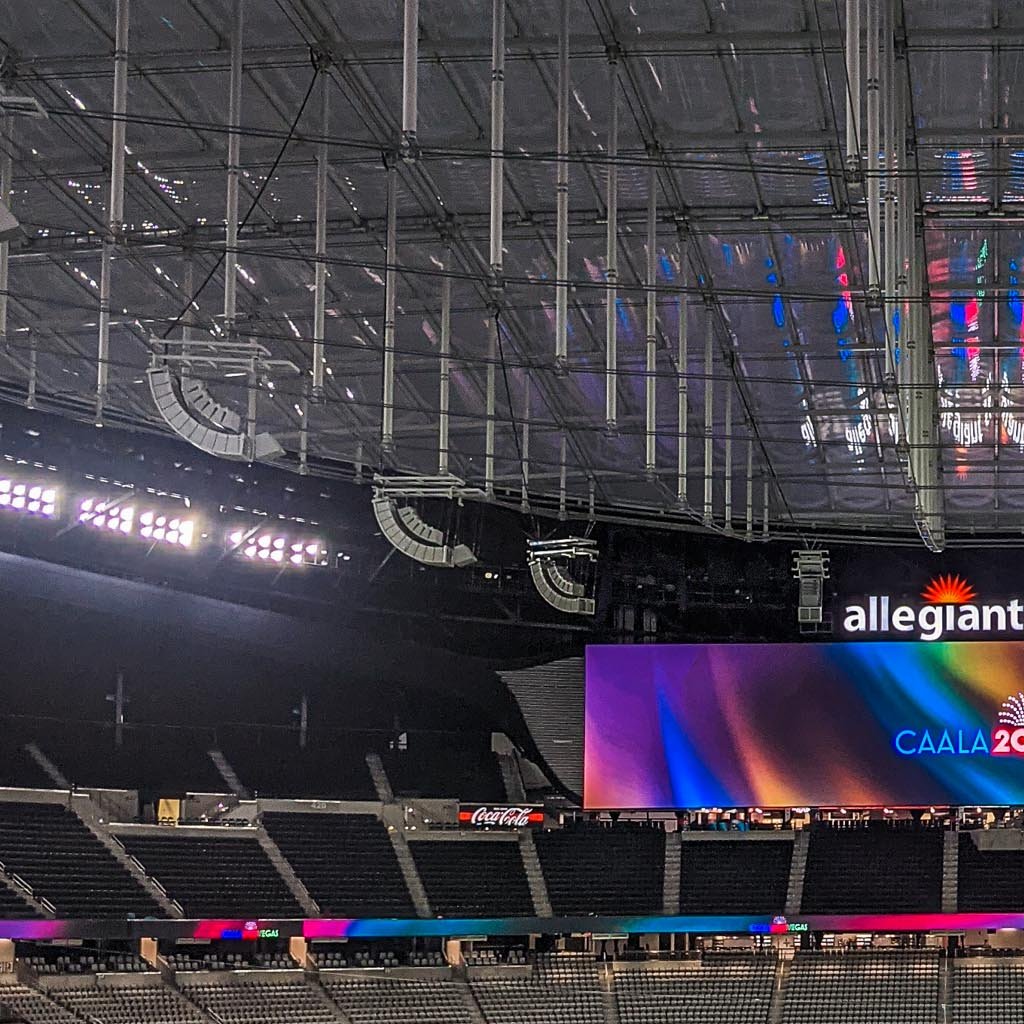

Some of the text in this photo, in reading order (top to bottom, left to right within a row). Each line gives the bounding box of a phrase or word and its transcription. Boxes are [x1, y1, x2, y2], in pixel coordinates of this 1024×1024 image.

[843, 595, 1024, 641] allegiant
[895, 728, 989, 755] CAALA
[471, 807, 534, 826] Coca-Cola
